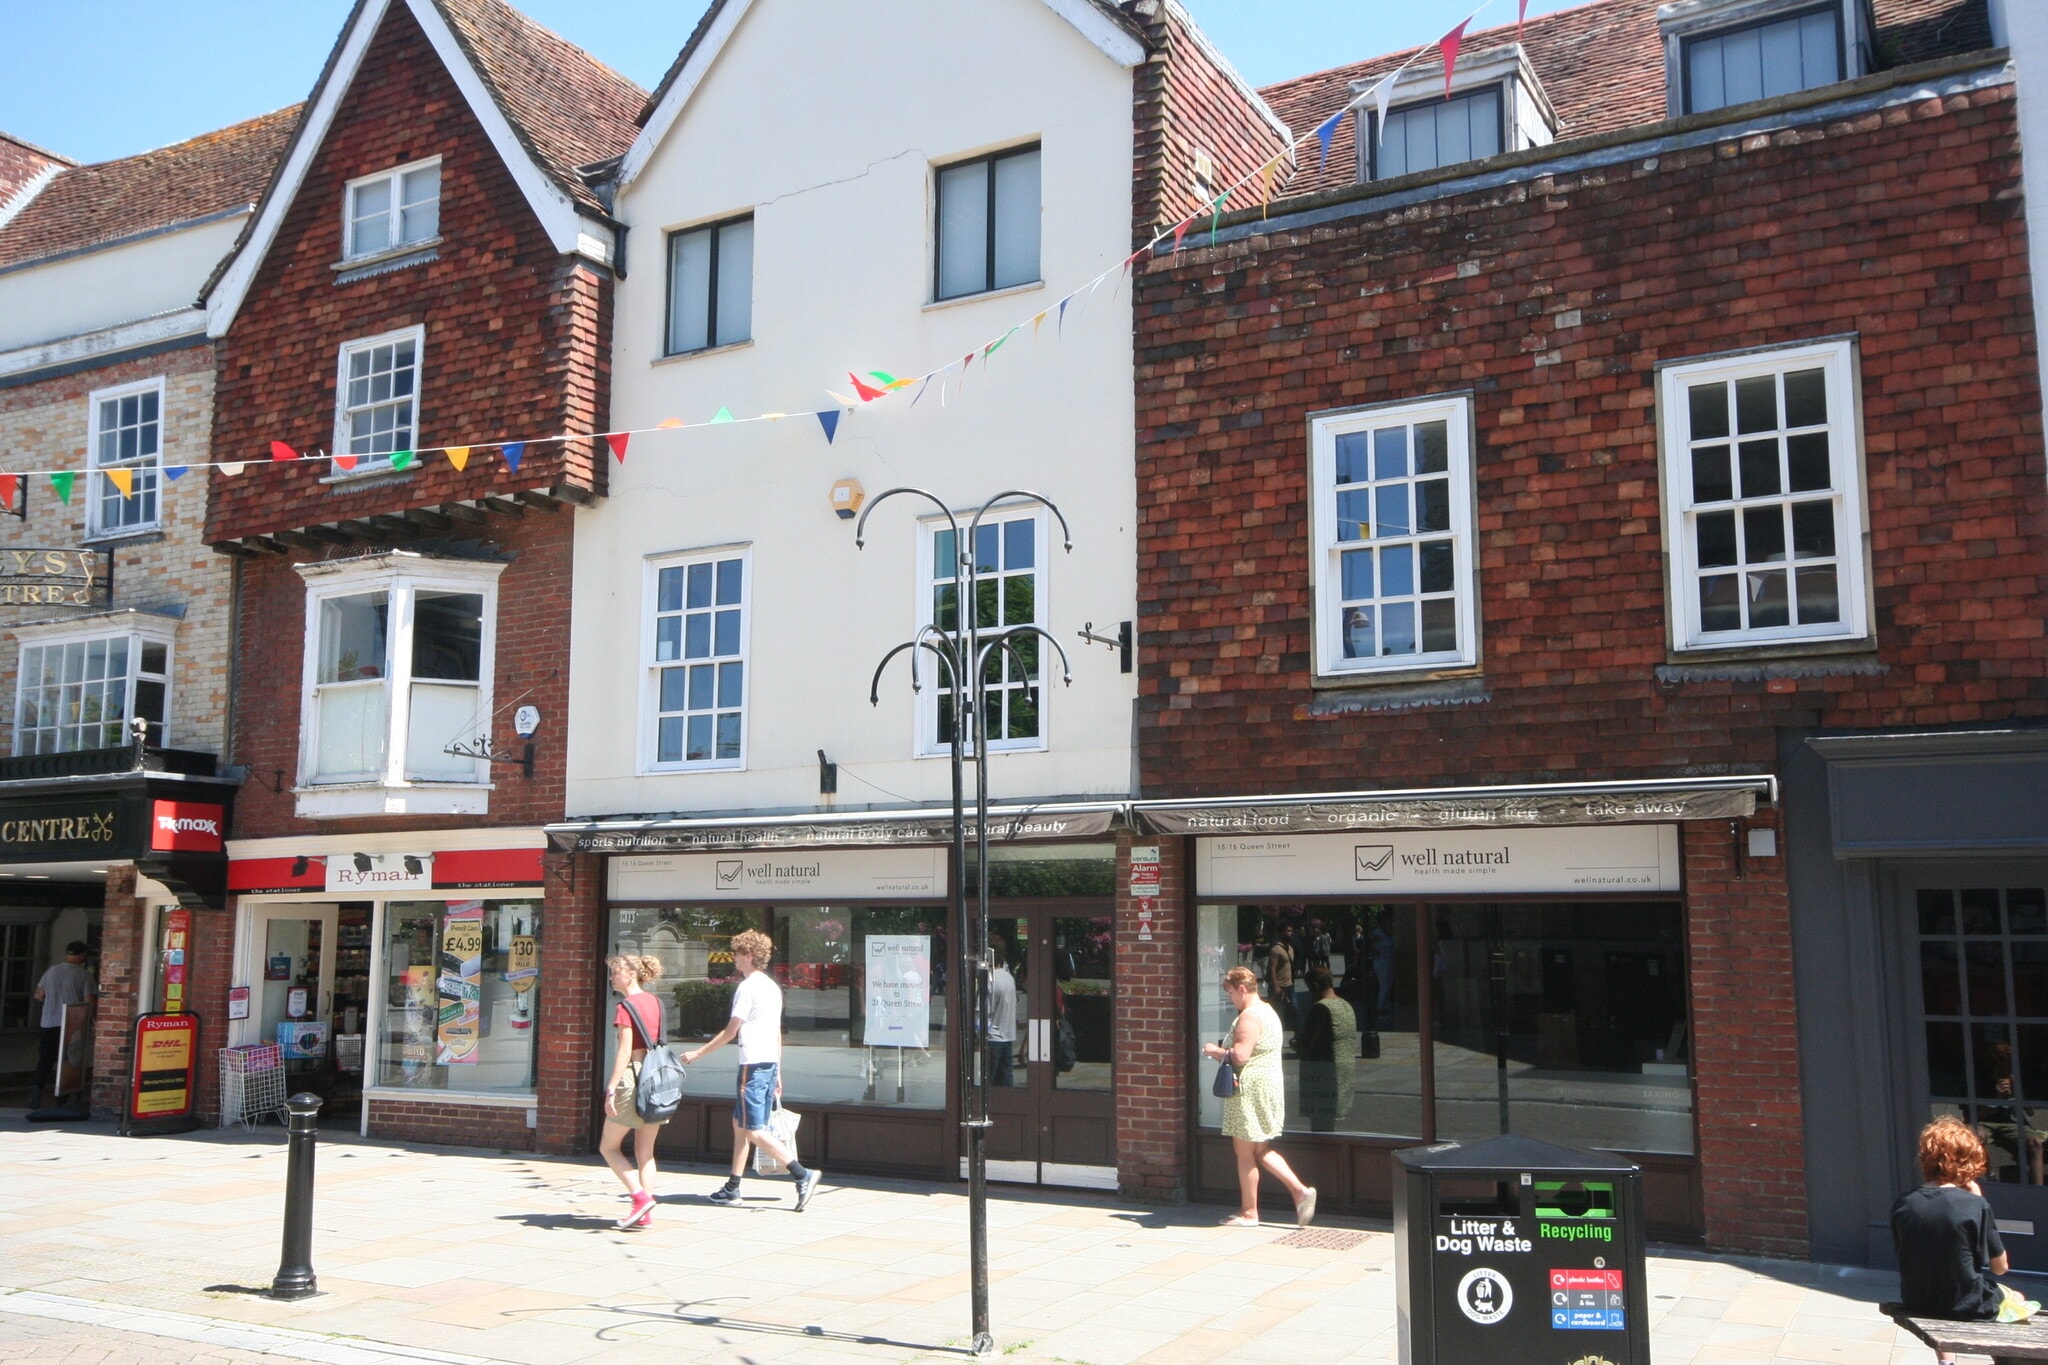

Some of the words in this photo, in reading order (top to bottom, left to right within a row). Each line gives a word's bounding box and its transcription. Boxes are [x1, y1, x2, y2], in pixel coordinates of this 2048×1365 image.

[0, 550, 68, 575] YS
[1187, 814, 1247, 827] natural
[1327, 809, 1397, 825] organic
[1439, 807, 1496, 823] gluten
[1585, 803, 1627, 816] take
[1634, 801, 1686, 816] away
[2, 817, 90, 843] CENTRE
[578, 837, 614, 849] sports
[617, 835, 666, 847] nutrition
[692, 832, 736, 844] natural
[806, 829, 854, 840] natural
[858, 827, 893, 841] body
[897, 828, 928, 838] care
[1014, 820, 1067, 834] beauty
[1401, 848, 1437, 866] well
[1443, 847, 1510, 865] natural
[747, 863, 772, 878] well
[775, 862, 820, 877] natural
[1132, 864, 1158, 872] Alarm
[1415, 867, 1440, 875] health
[1468, 867, 1496, 875] simple
[1573, 875, 1652, 884] wellnatural.co.uk
[445, 937, 481, 952] £4.99
[513, 941, 533, 956] 130
[887, 944, 900, 952] well
[901, 944, 924, 952] natural
[883, 981, 899, 989] have
[146, 1020, 189, 1029] Ryman
[152, 1039, 181, 1048] DHL
[1450, 1219, 1498, 1236] Litter
[1502, 1220, 1516, 1236] &
[1540, 1223, 1612, 1242] Recycling
[1436, 1235, 1472, 1255] Dog
[1477, 1236, 1532, 1252] Waste
[1473, 1270, 1497, 1279] LITTER
[1568, 1276, 1586, 1284] plastic
[1586, 1276, 1605, 1284] bottles
[1466, 1308, 1481, 1320] DOG
[1482, 1310, 1504, 1321] WASTE
[1574, 1312, 1595, 1320] paper
